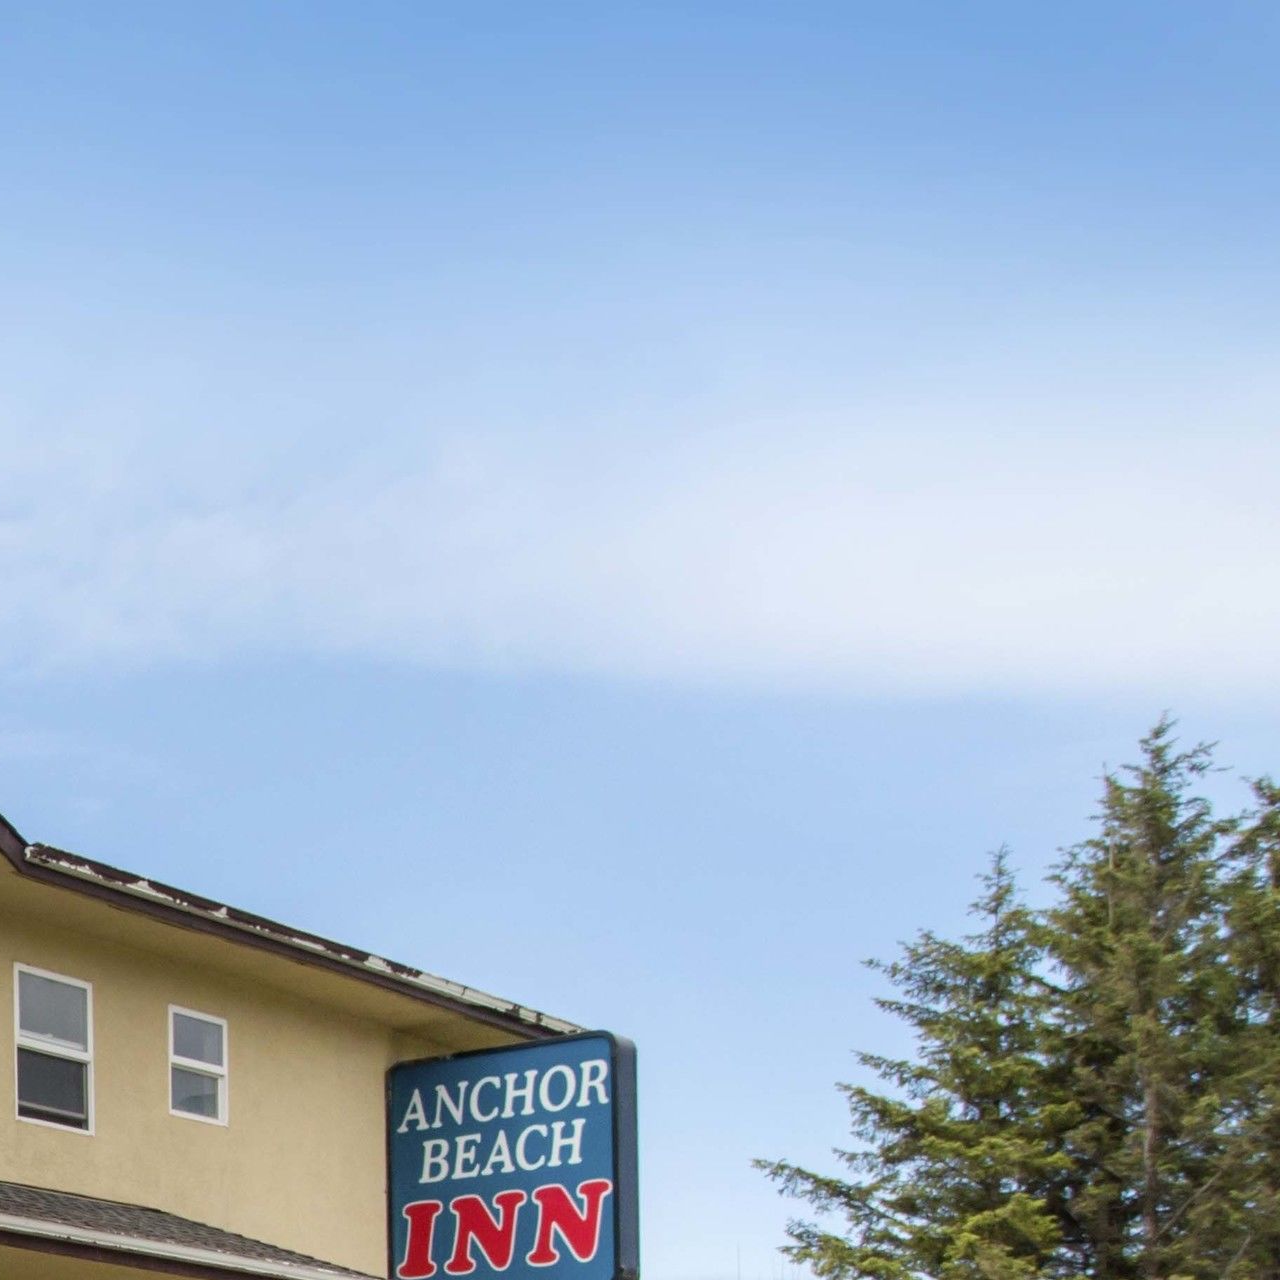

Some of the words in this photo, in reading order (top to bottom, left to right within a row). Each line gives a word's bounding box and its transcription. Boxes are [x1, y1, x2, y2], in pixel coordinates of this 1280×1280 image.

[396, 1058, 610, 1134] ANCHOR
[418, 1118, 586, 1184] BEACH
[396, 1178, 613, 1280] INN
